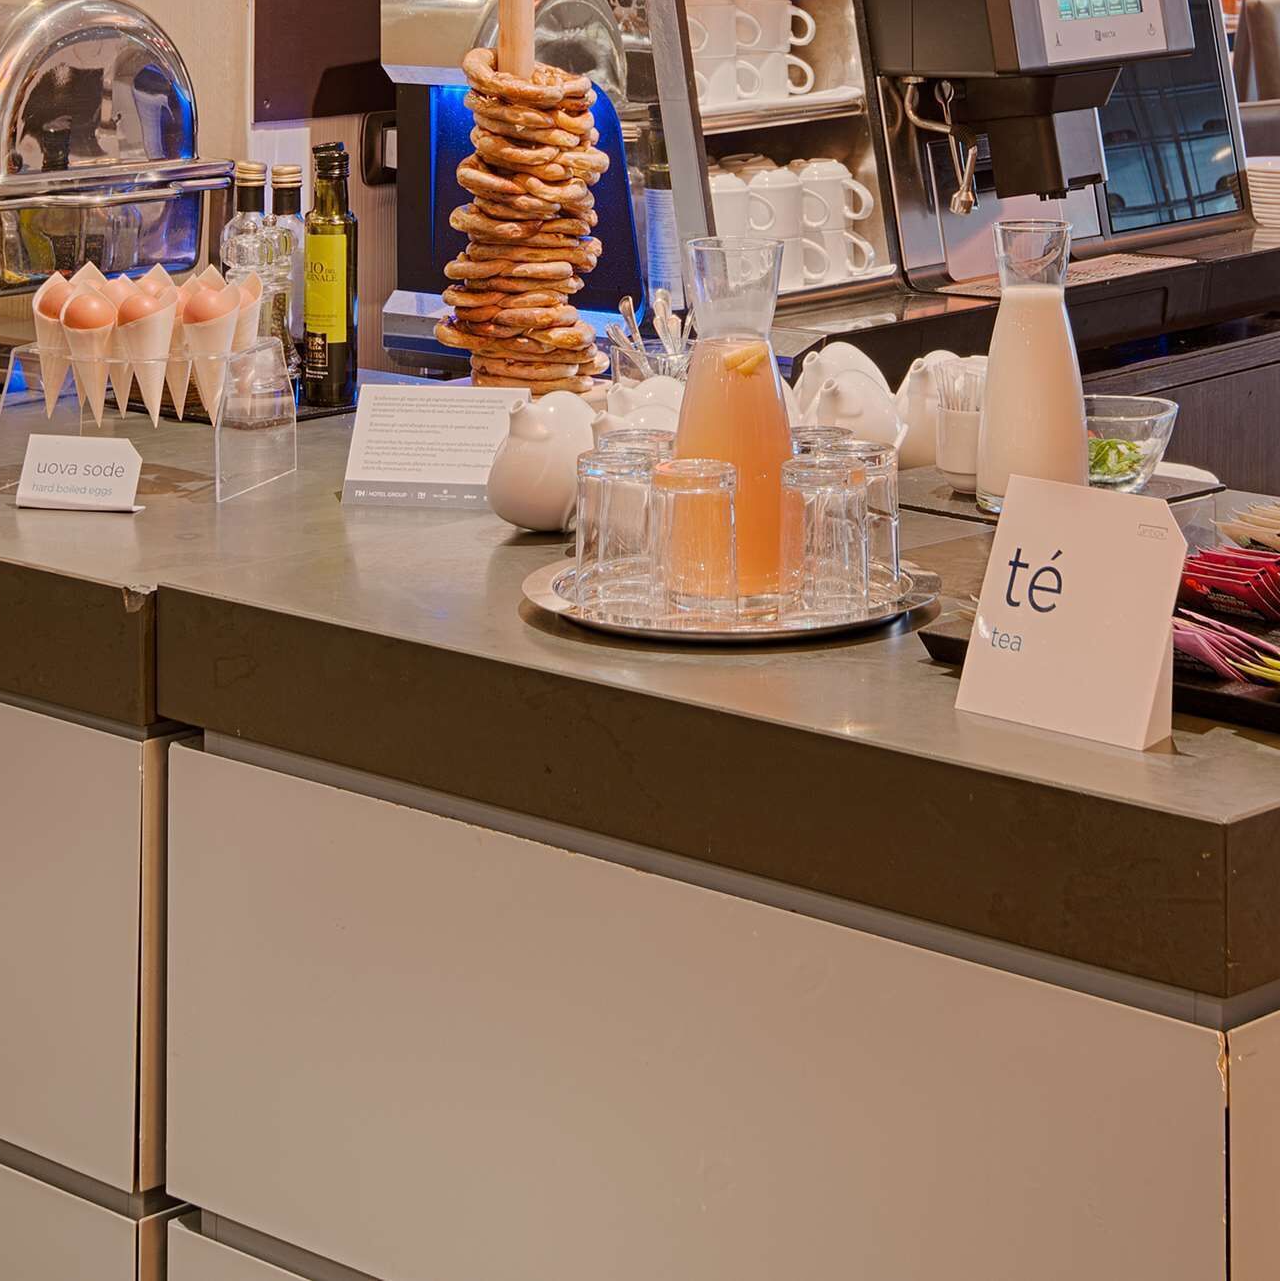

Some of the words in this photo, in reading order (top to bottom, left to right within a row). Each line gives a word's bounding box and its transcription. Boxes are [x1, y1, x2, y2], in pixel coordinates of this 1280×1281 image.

[37, 462, 78, 476] uova
[82, 462, 126, 478] sode
[32, 482, 55, 493] hard
[56, 482, 88, 495] boiled
[88, 485, 113, 497] eggs
[1006, 547, 1063, 613] té
[991, 627, 1022, 651] tea
